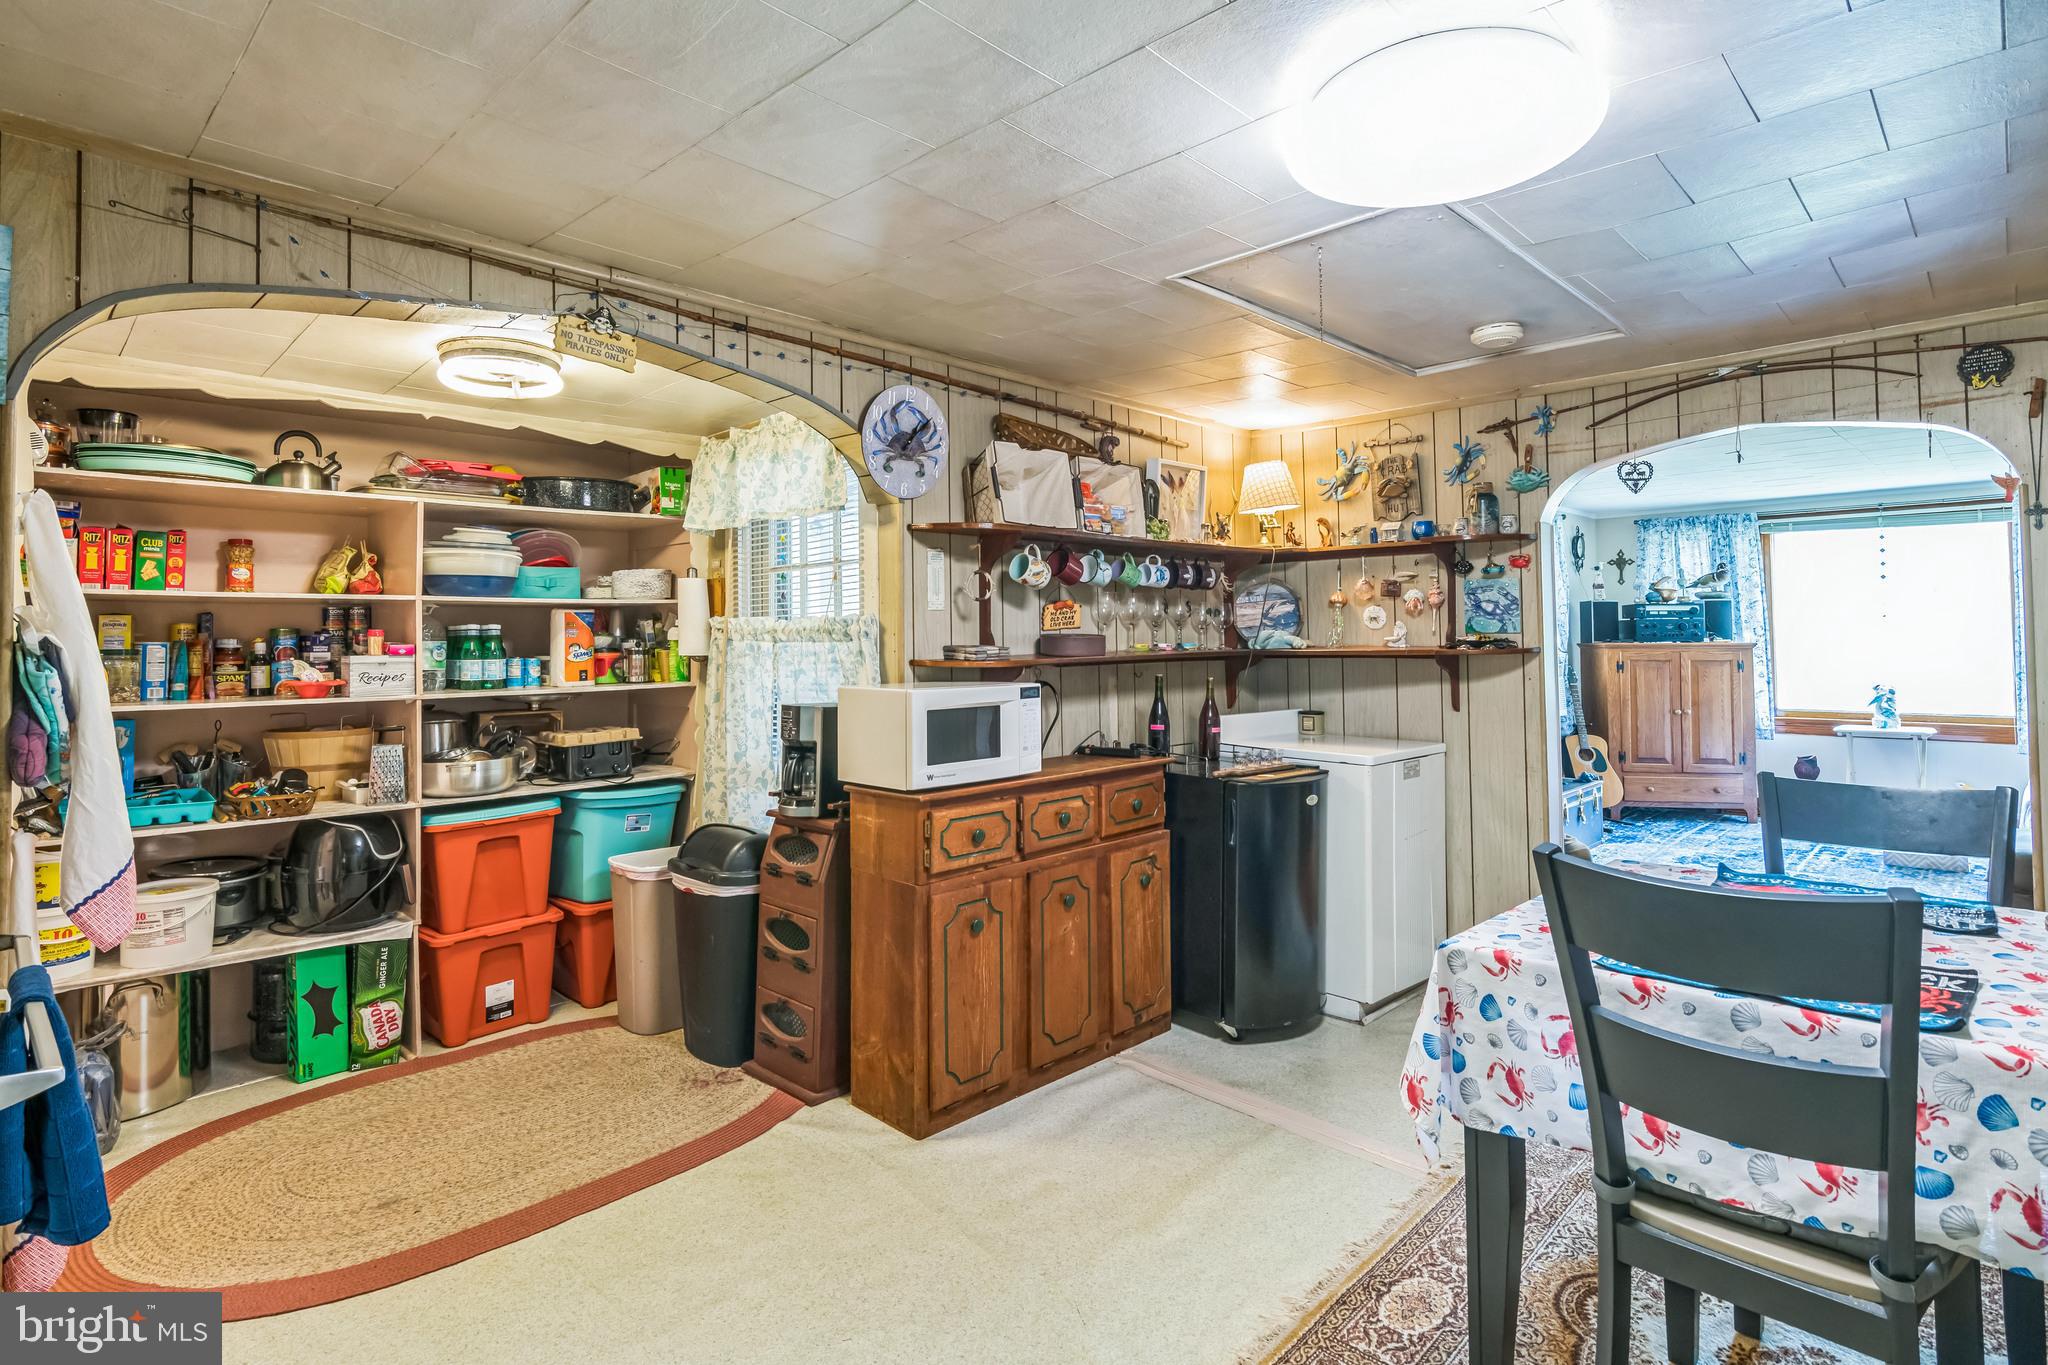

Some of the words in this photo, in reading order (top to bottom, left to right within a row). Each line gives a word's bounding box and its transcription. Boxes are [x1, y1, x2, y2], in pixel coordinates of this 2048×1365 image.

[560, 329, 574, 340] NO
[576, 333, 635, 358] TRESPASSING
[565, 339, 603, 357] PIRATES
[604, 351, 628, 364] ONLY
[887, 390, 896, 405] 11
[905, 386, 918, 402] 12
[925, 396, 930, 411] 1
[872, 405, 883, 420] 10
[937, 416, 945, 431] 2
[865, 429, 874, 442] 9
[868, 455, 877, 469] 8
[1381, 464, 1408, 477] CRAB
[883, 475, 891, 489] 7
[900, 482, 908, 497] 6
[919, 479, 927, 494] 5
[1387, 503, 1405, 514] HUT
[83, 531, 102, 543] RITZ
[112, 533, 131, 545] RITZ
[169, 534, 185, 544] RITZ
[215, 674, 246, 683] SPAM
[358, 671, 407, 687] Recipes
[381, 946, 389, 961] ALE
[379, 961, 388, 989] GINGER
[368, 1000, 389, 1049] CANADA
[384, 1007, 400, 1032] DRY
[351, 1063, 361, 1072] 12
